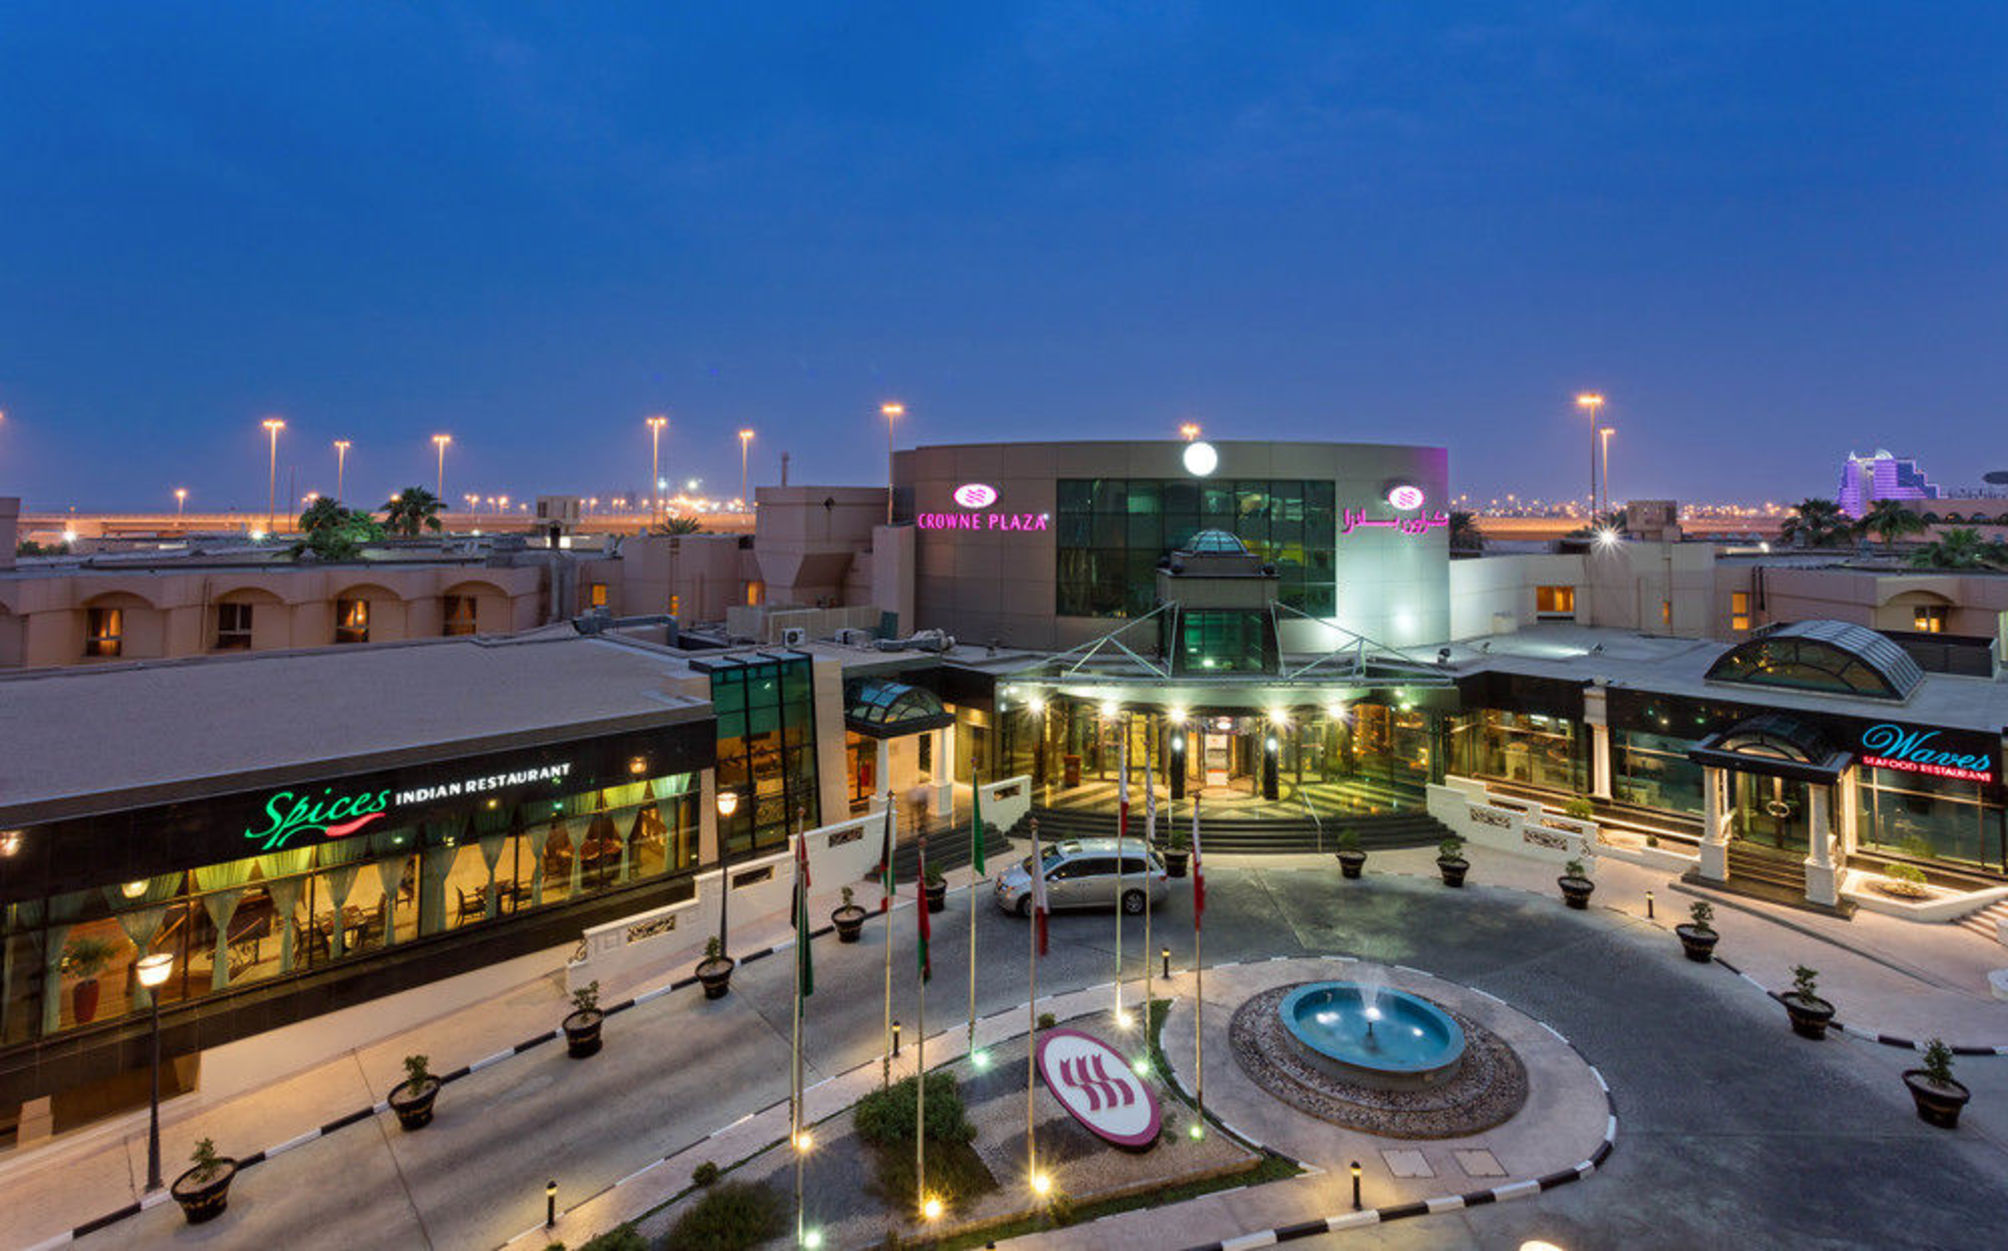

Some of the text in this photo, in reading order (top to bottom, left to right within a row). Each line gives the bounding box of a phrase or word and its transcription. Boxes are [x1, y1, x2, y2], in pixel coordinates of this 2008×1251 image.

[917, 512, 1047, 531] CROWNE PLAZA
[1862, 724, 1991, 772] Waves
[1862, 755, 1993, 783] SEAFOOD RESTAURANT
[244, 762, 572, 850] Spices INDIAN RESTAURANT
